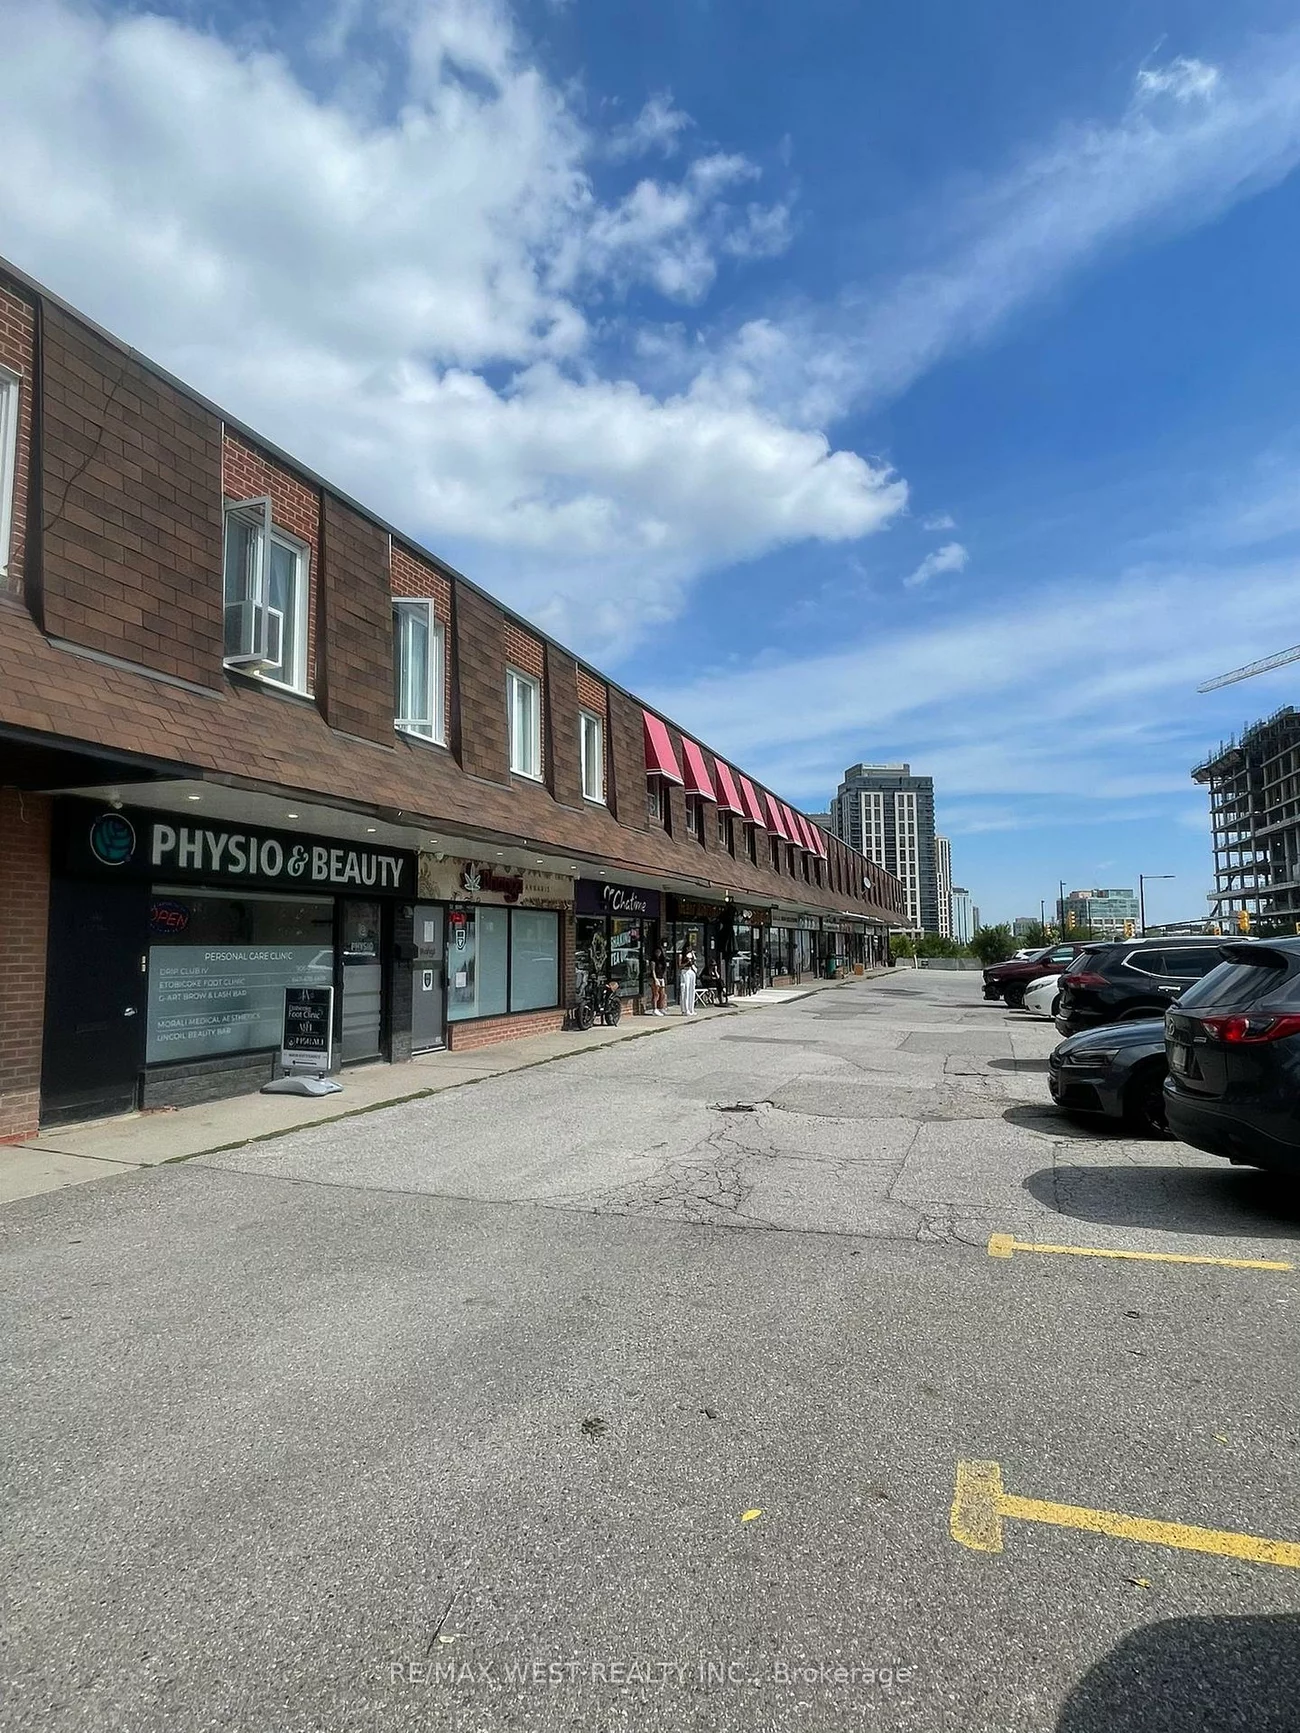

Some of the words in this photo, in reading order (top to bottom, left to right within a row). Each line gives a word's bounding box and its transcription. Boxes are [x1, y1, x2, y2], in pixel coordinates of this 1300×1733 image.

[152, 823, 283, 877] PHYSIO
[288, 845, 309, 877] &
[312, 846, 404, 888] BEAUTY
[612, 889, 647, 912] Chatime
[150, 908, 189, 929] OPEN
[205, 951, 248, 961] PERSONAL
[249, 951, 269, 961] CARE
[270, 951, 293, 961] CLINIC
[159, 968, 179, 976] DRIP
[180, 967, 200, 975] CLUB
[159, 980, 201, 989] ETOBICOKE
[203, 979, 222, 987] FOOT
[223, 978, 246, 986] CLINIC
[183, 992, 207, 1001] BROW
[188, 1017, 221, 1027] MEDICAL
[188, 1029, 216, 1038] BEAUTY
